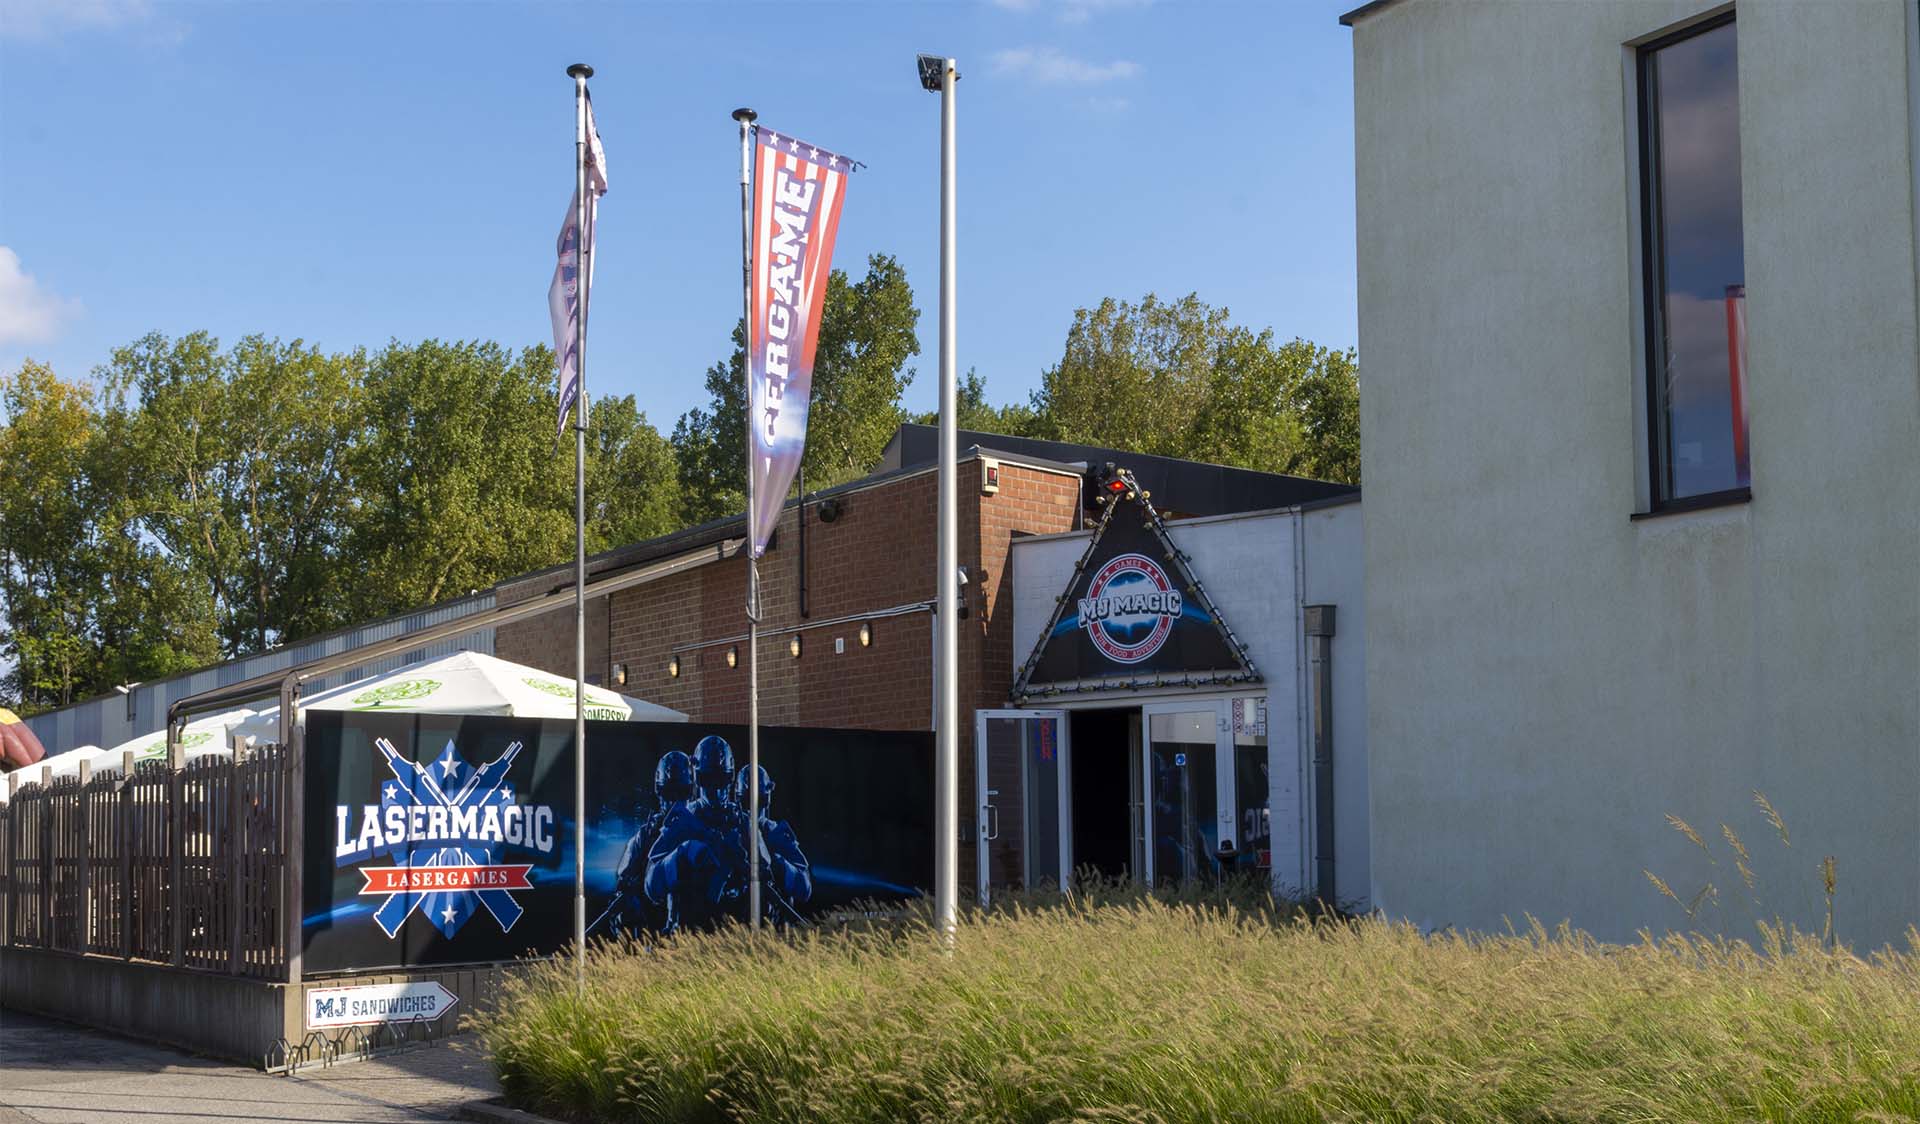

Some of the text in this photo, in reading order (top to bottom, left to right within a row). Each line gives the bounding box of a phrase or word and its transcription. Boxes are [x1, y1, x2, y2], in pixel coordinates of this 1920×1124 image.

[1079, 591, 1182, 626] MJ MAGIC
[335, 804, 553, 858] LASERMAGIC
[386, 870, 508, 888] LASERGAMES
[315, 995, 436, 1019] MJ SANDWICHES
